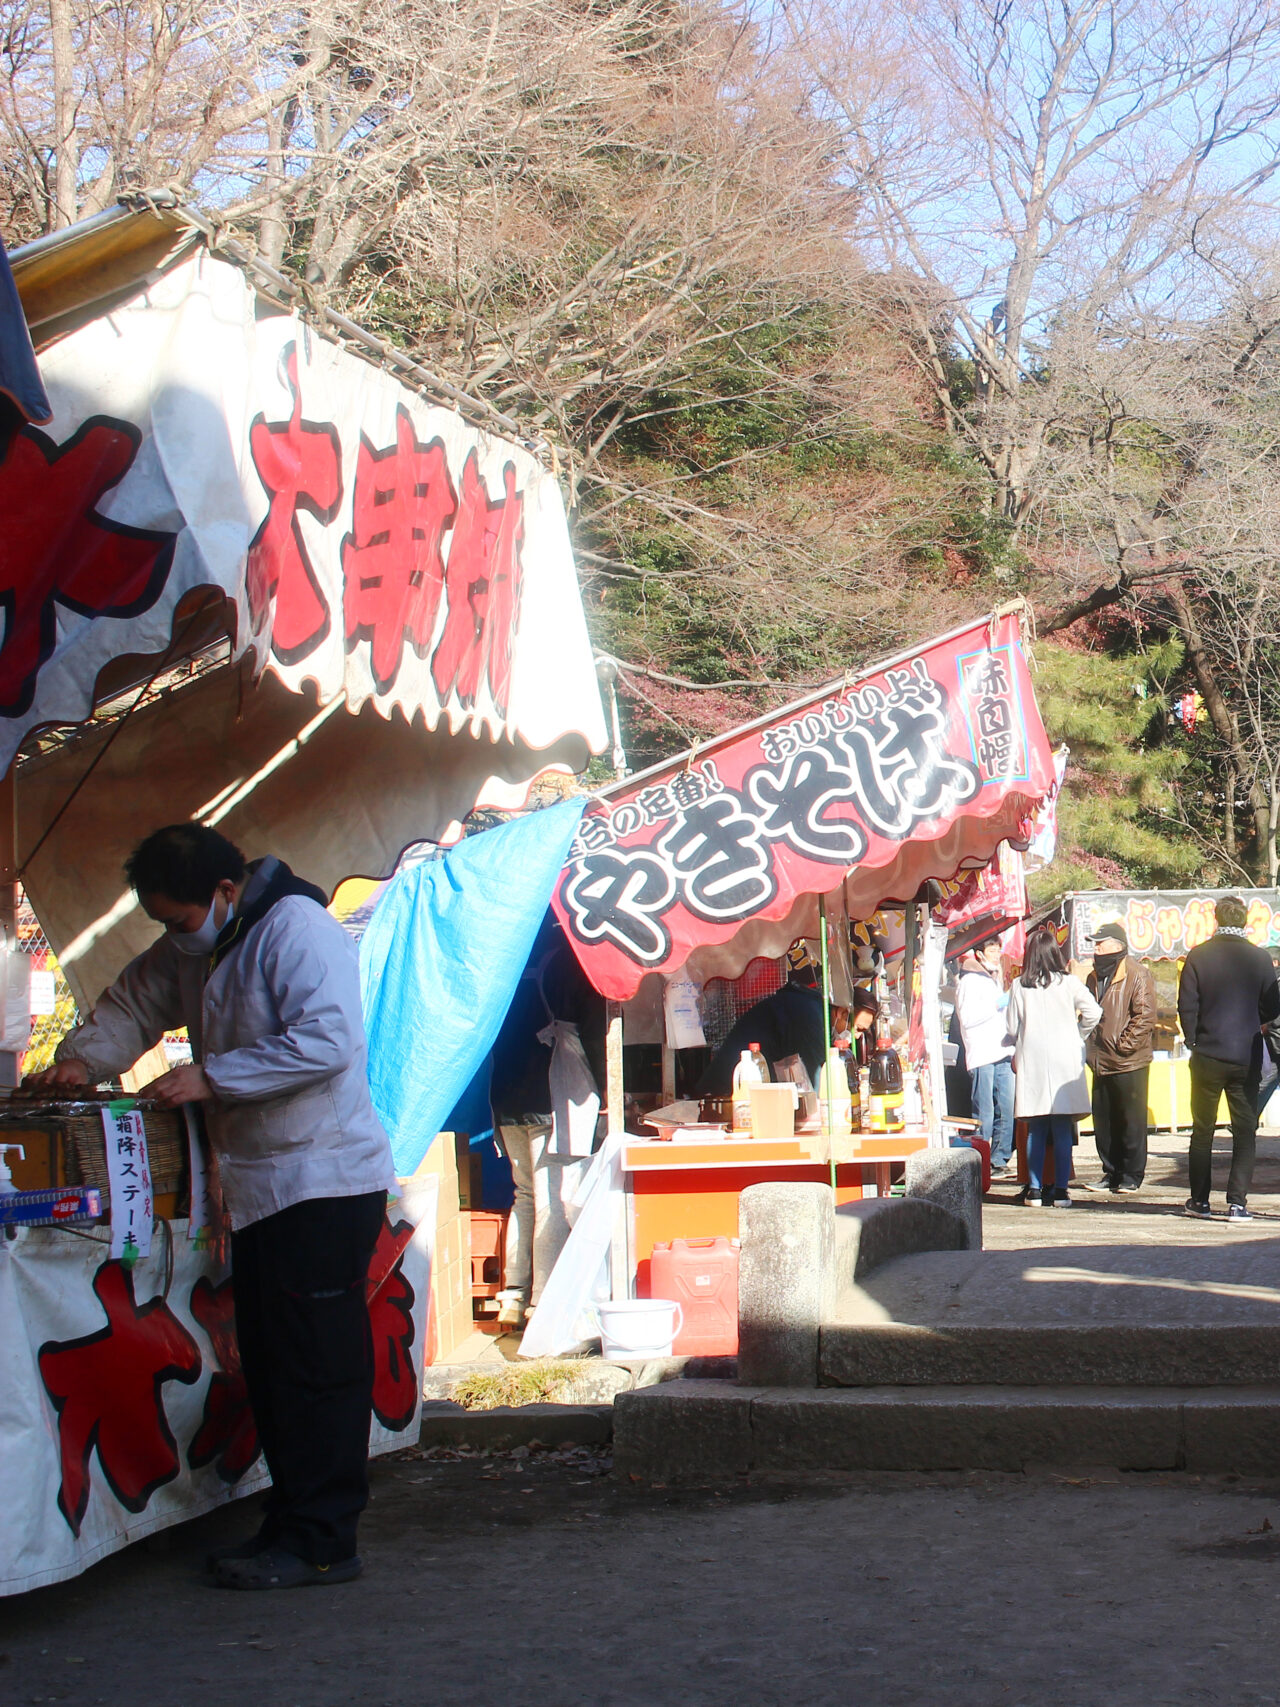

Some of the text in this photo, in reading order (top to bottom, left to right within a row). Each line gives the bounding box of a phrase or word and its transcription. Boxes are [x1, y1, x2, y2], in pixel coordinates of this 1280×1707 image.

[966, 656, 1020, 778] 味自慢
[562, 690, 980, 966] やきそば
[115, 1112, 141, 1251] 霜降ステーキ
